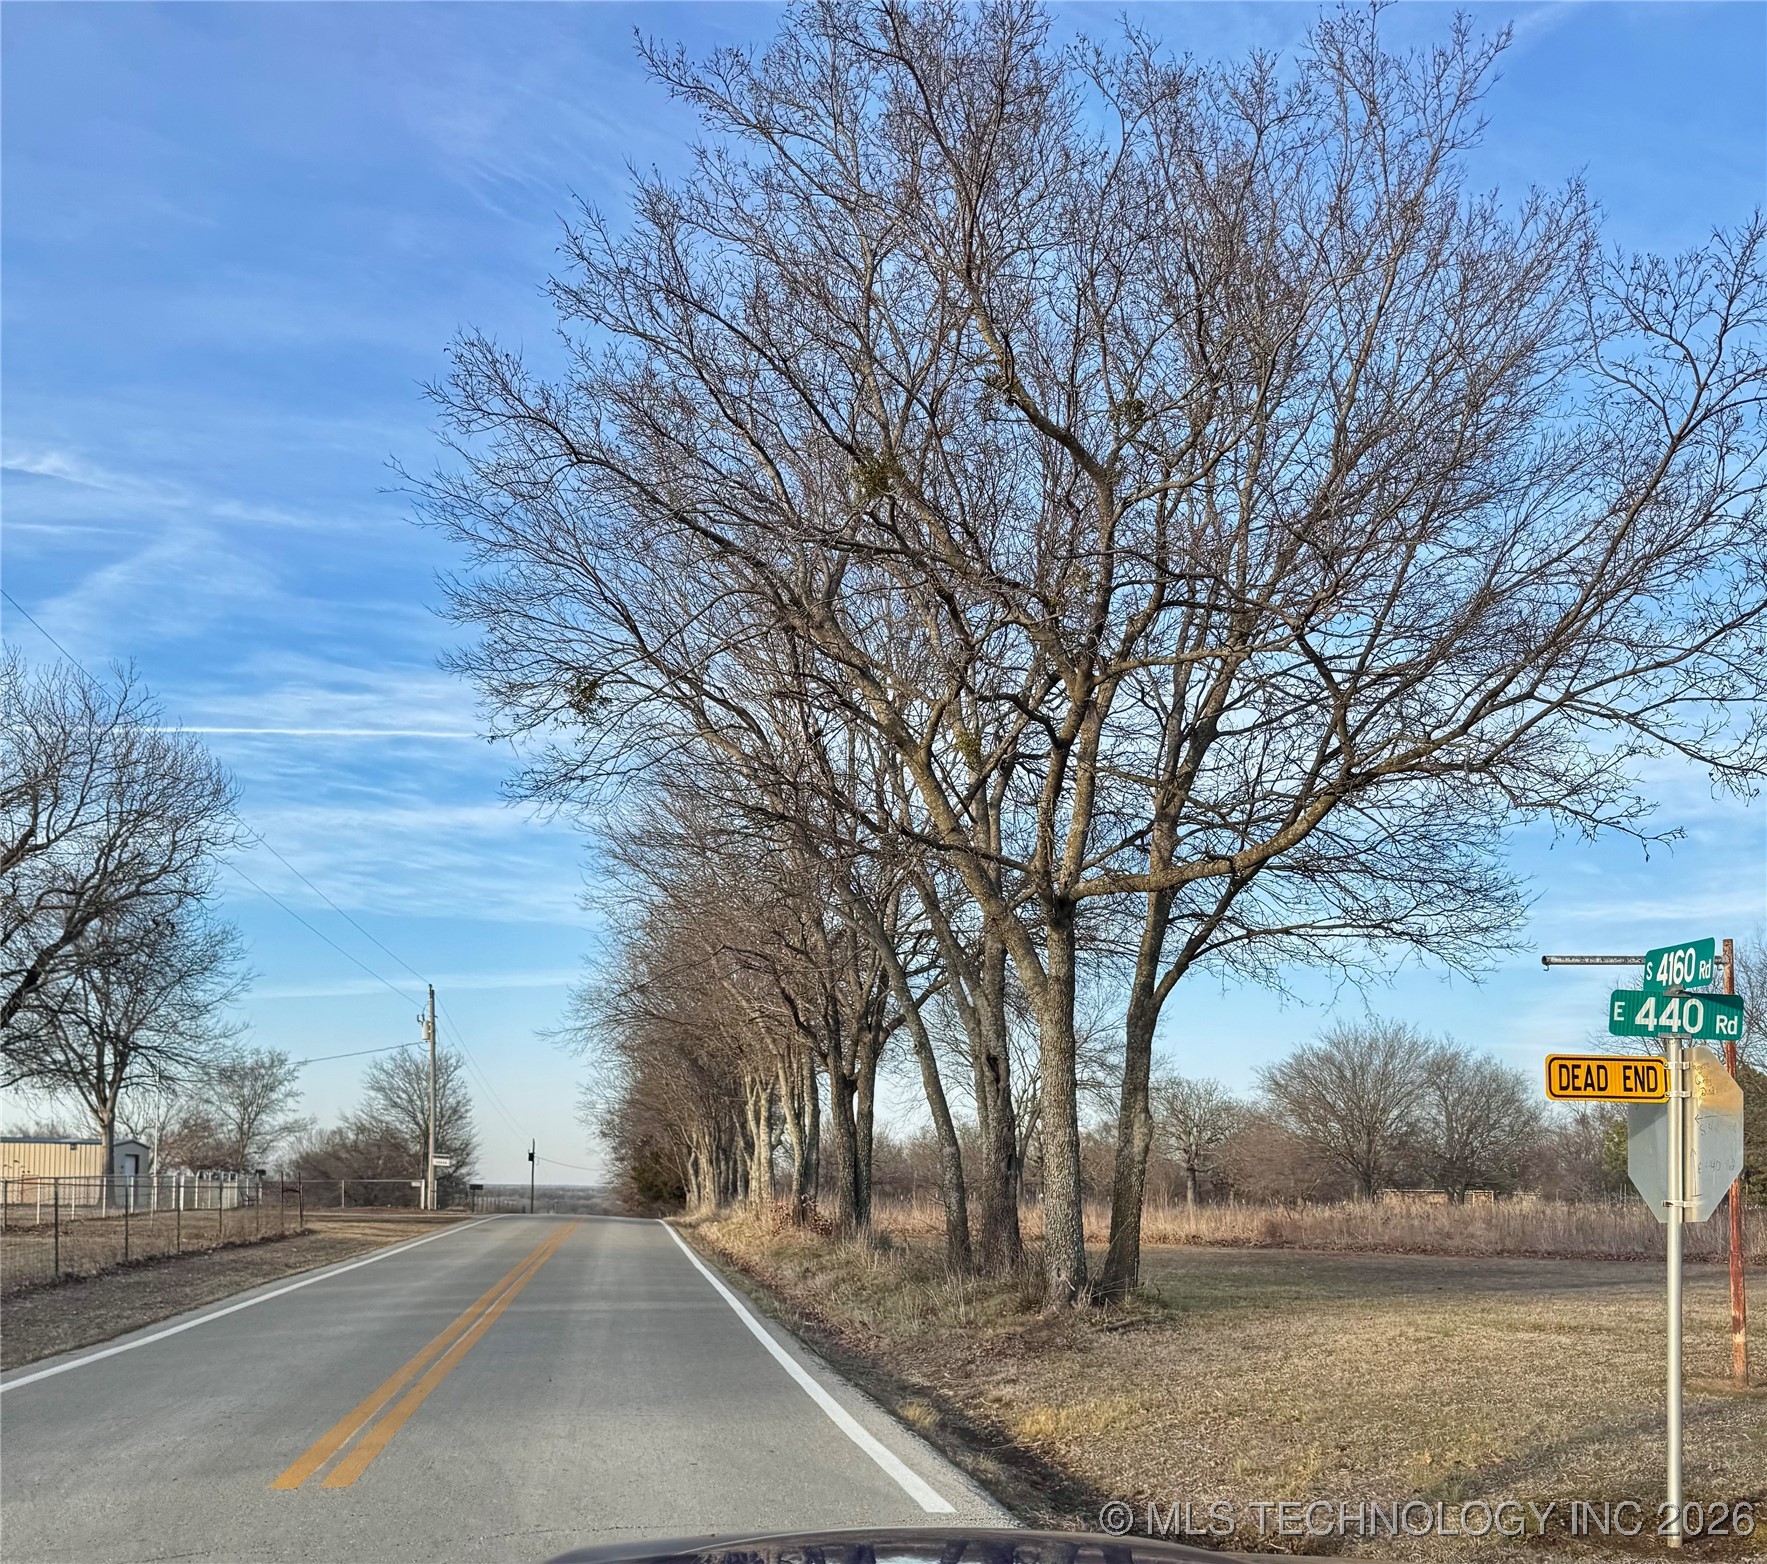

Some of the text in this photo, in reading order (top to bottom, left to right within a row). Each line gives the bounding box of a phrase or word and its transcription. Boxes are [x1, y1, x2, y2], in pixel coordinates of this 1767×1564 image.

[1646, 947, 1711, 986] S 4160 Rd
[1613, 996, 1738, 1035] E 440 Rd
[1558, 1063, 1609, 1092] DEAD
[1623, 1065, 1658, 1093] END
